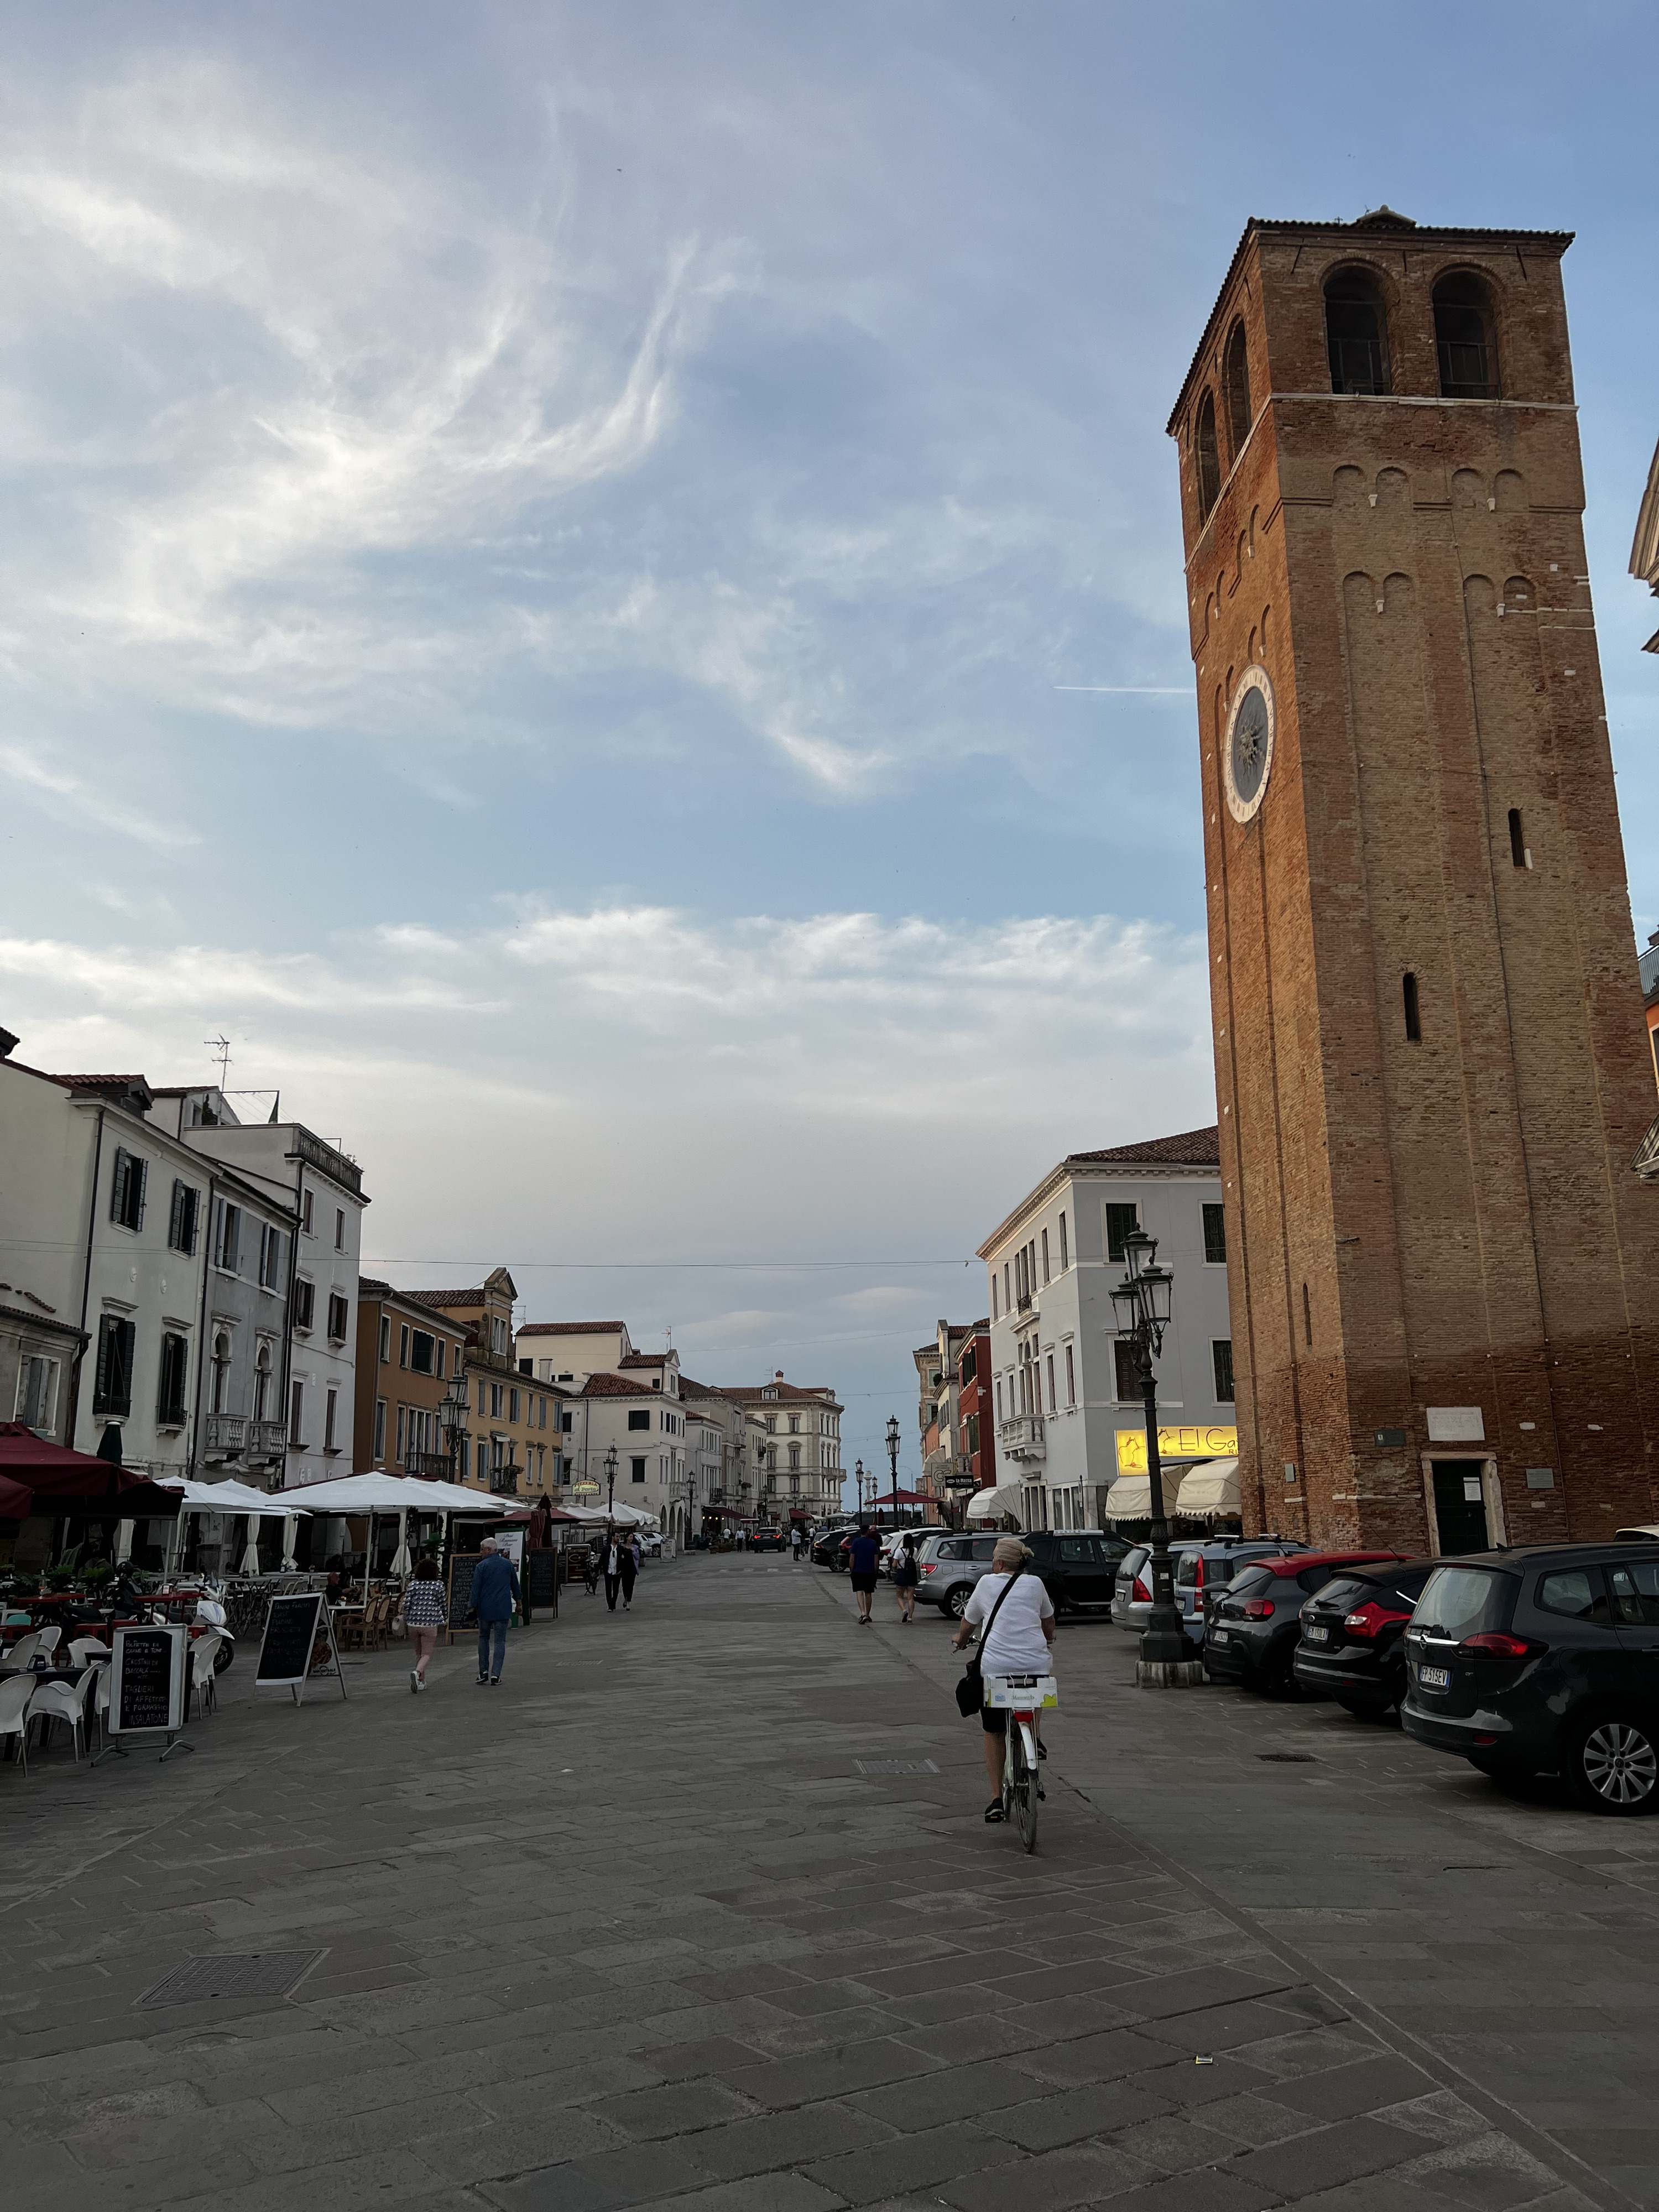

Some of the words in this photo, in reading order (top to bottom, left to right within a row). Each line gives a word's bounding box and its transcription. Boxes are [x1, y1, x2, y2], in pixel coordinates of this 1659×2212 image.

[1206, 1428, 1238, 1451] Ga
[1428, 1667, 1447, 1684] 515EV
[124, 1684, 154, 1693] TAGLIERI
[129, 1713, 169, 1725] INSALATONE
